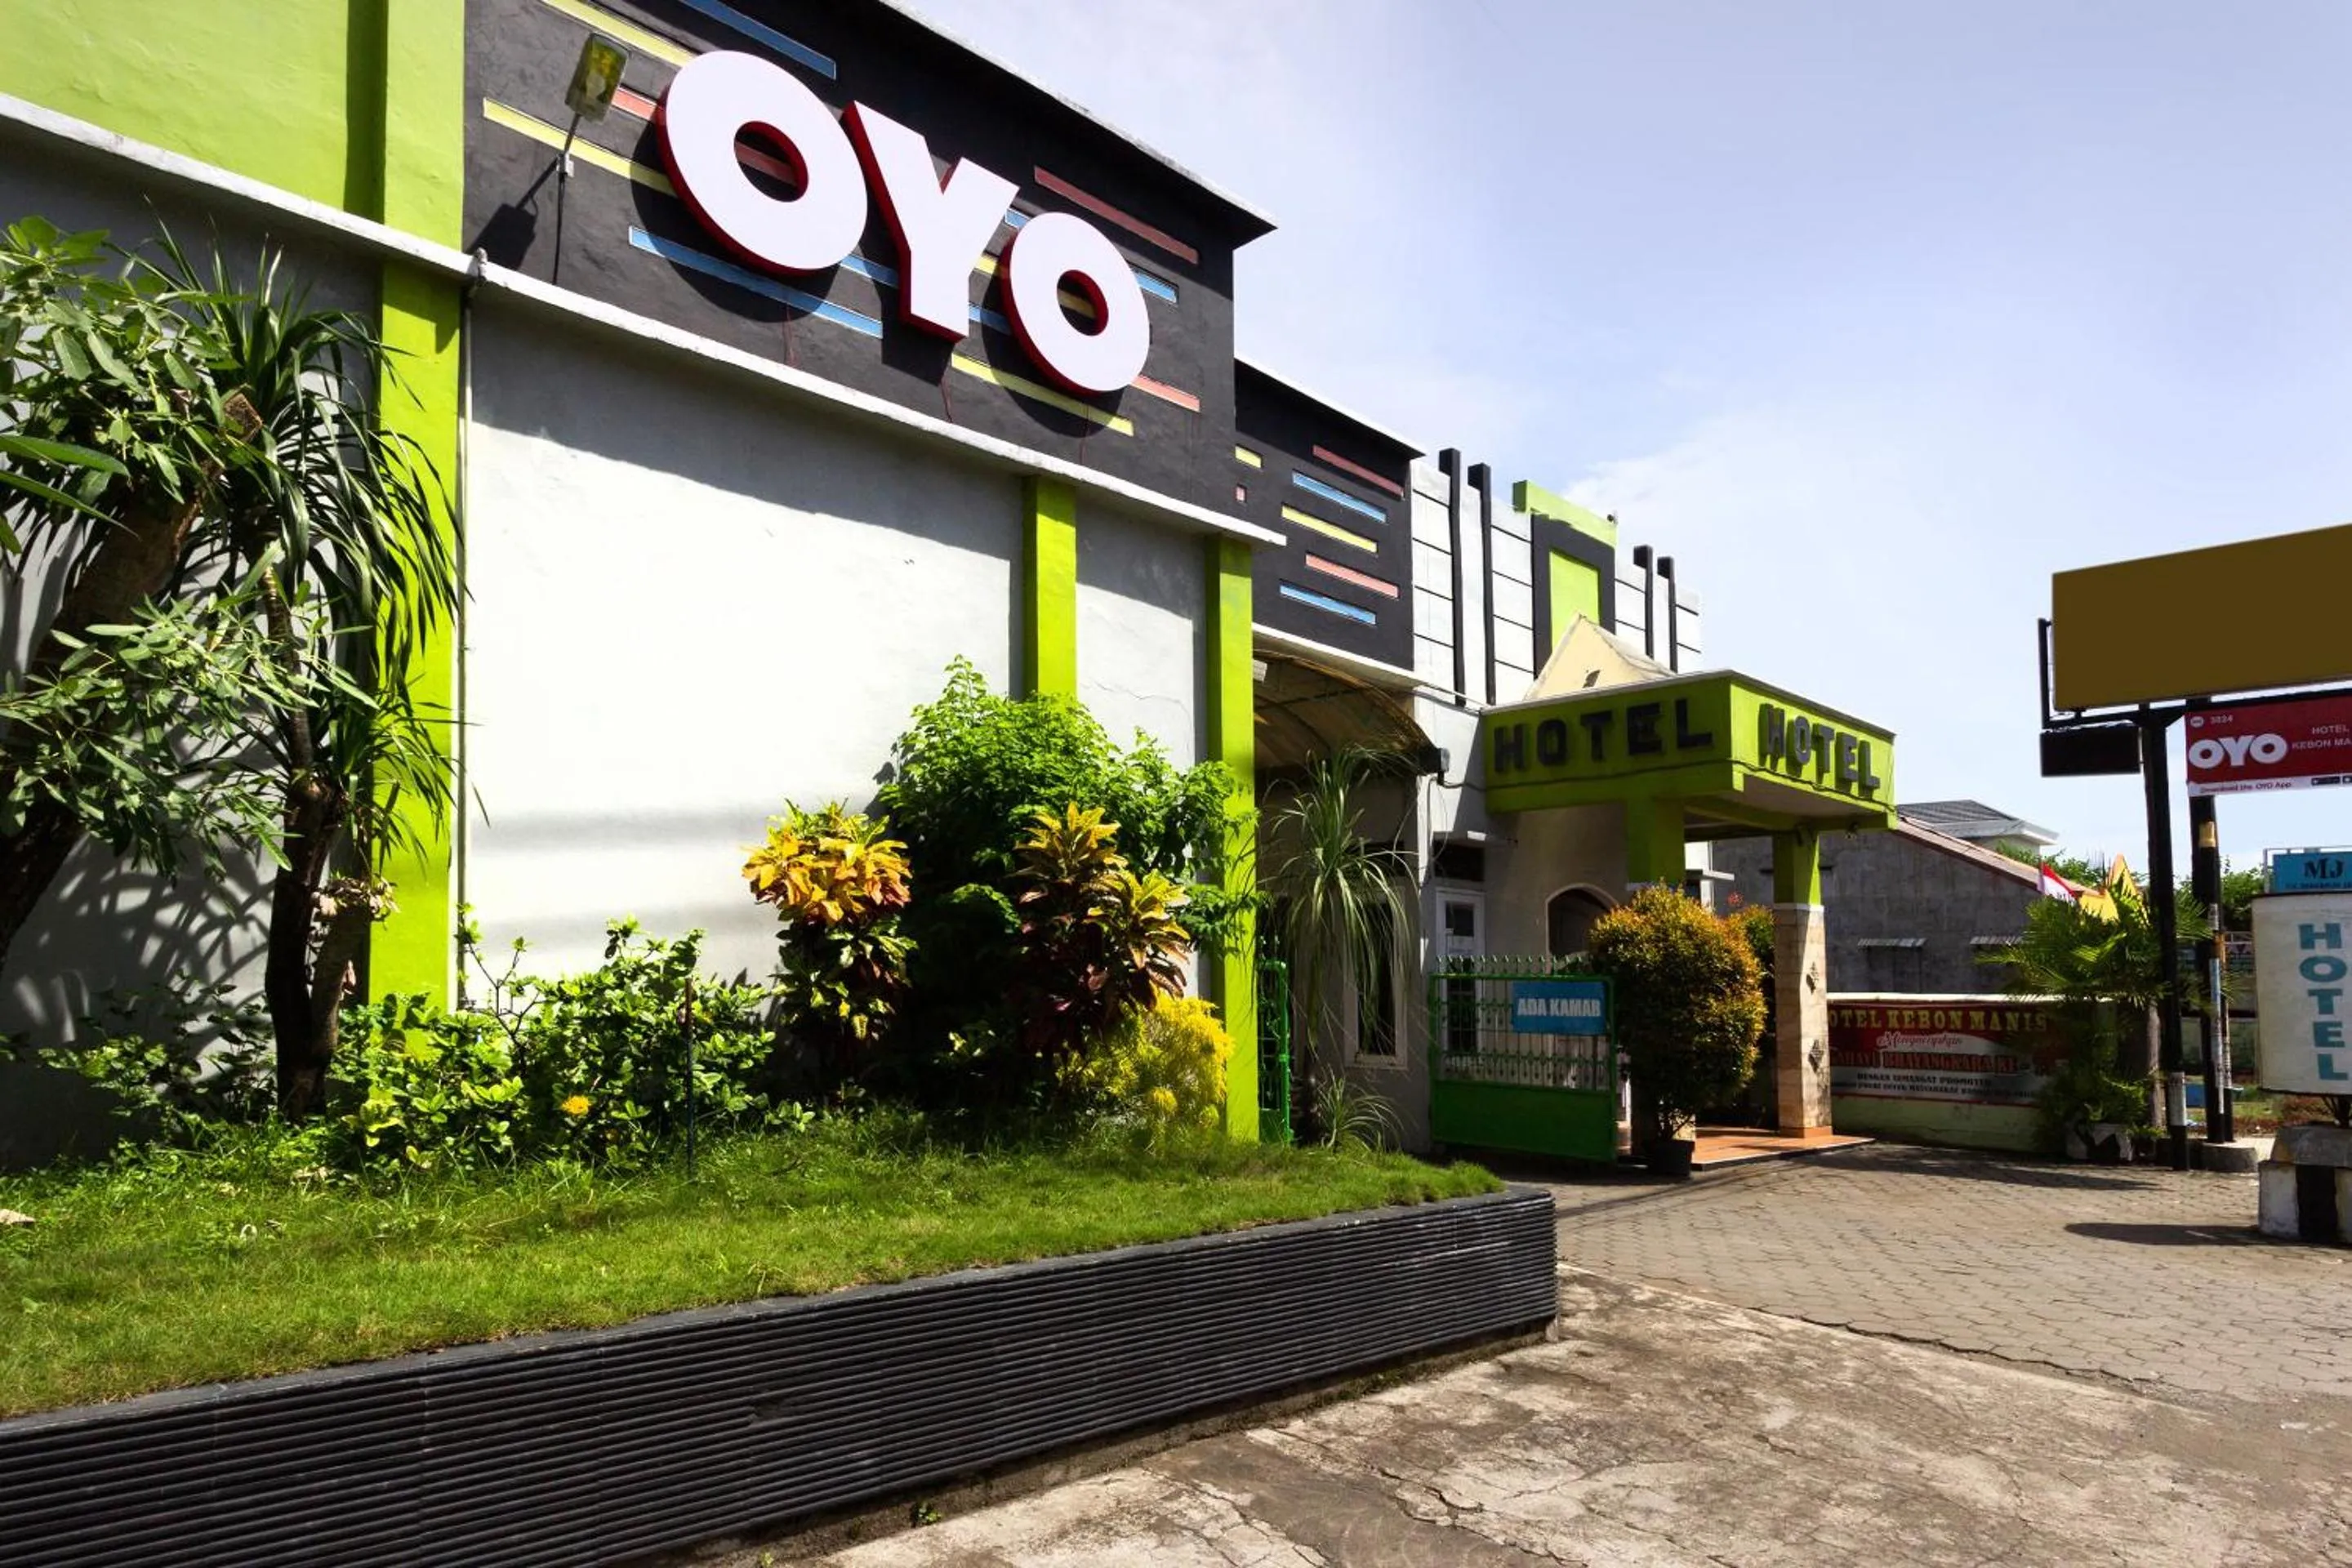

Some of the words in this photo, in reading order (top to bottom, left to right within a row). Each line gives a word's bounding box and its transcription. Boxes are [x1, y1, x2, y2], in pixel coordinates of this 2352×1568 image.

[656, 50, 1151, 394] OYO
[1493, 697, 1715, 773] HOTEL
[2312, 724, 2350, 734] HOTEL
[1761, 703, 1881, 794] HOTEL
[2189, 733, 2287, 769] OYO
[2292, 739, 2332, 749] KEBON
[2274, 782, 2292, 790] App
[2303, 858, 2344, 880] MJ
[1517, 997, 1546, 1017] ADA
[1549, 998, 1601, 1017] KAMAR
[2298, 923, 2350, 1080] HOTEL
[1829, 1009, 1882, 1029] OTEL
[1888, 1009, 1963, 1031] KEBON
[1969, 1011, 2047, 1032] MANIS
